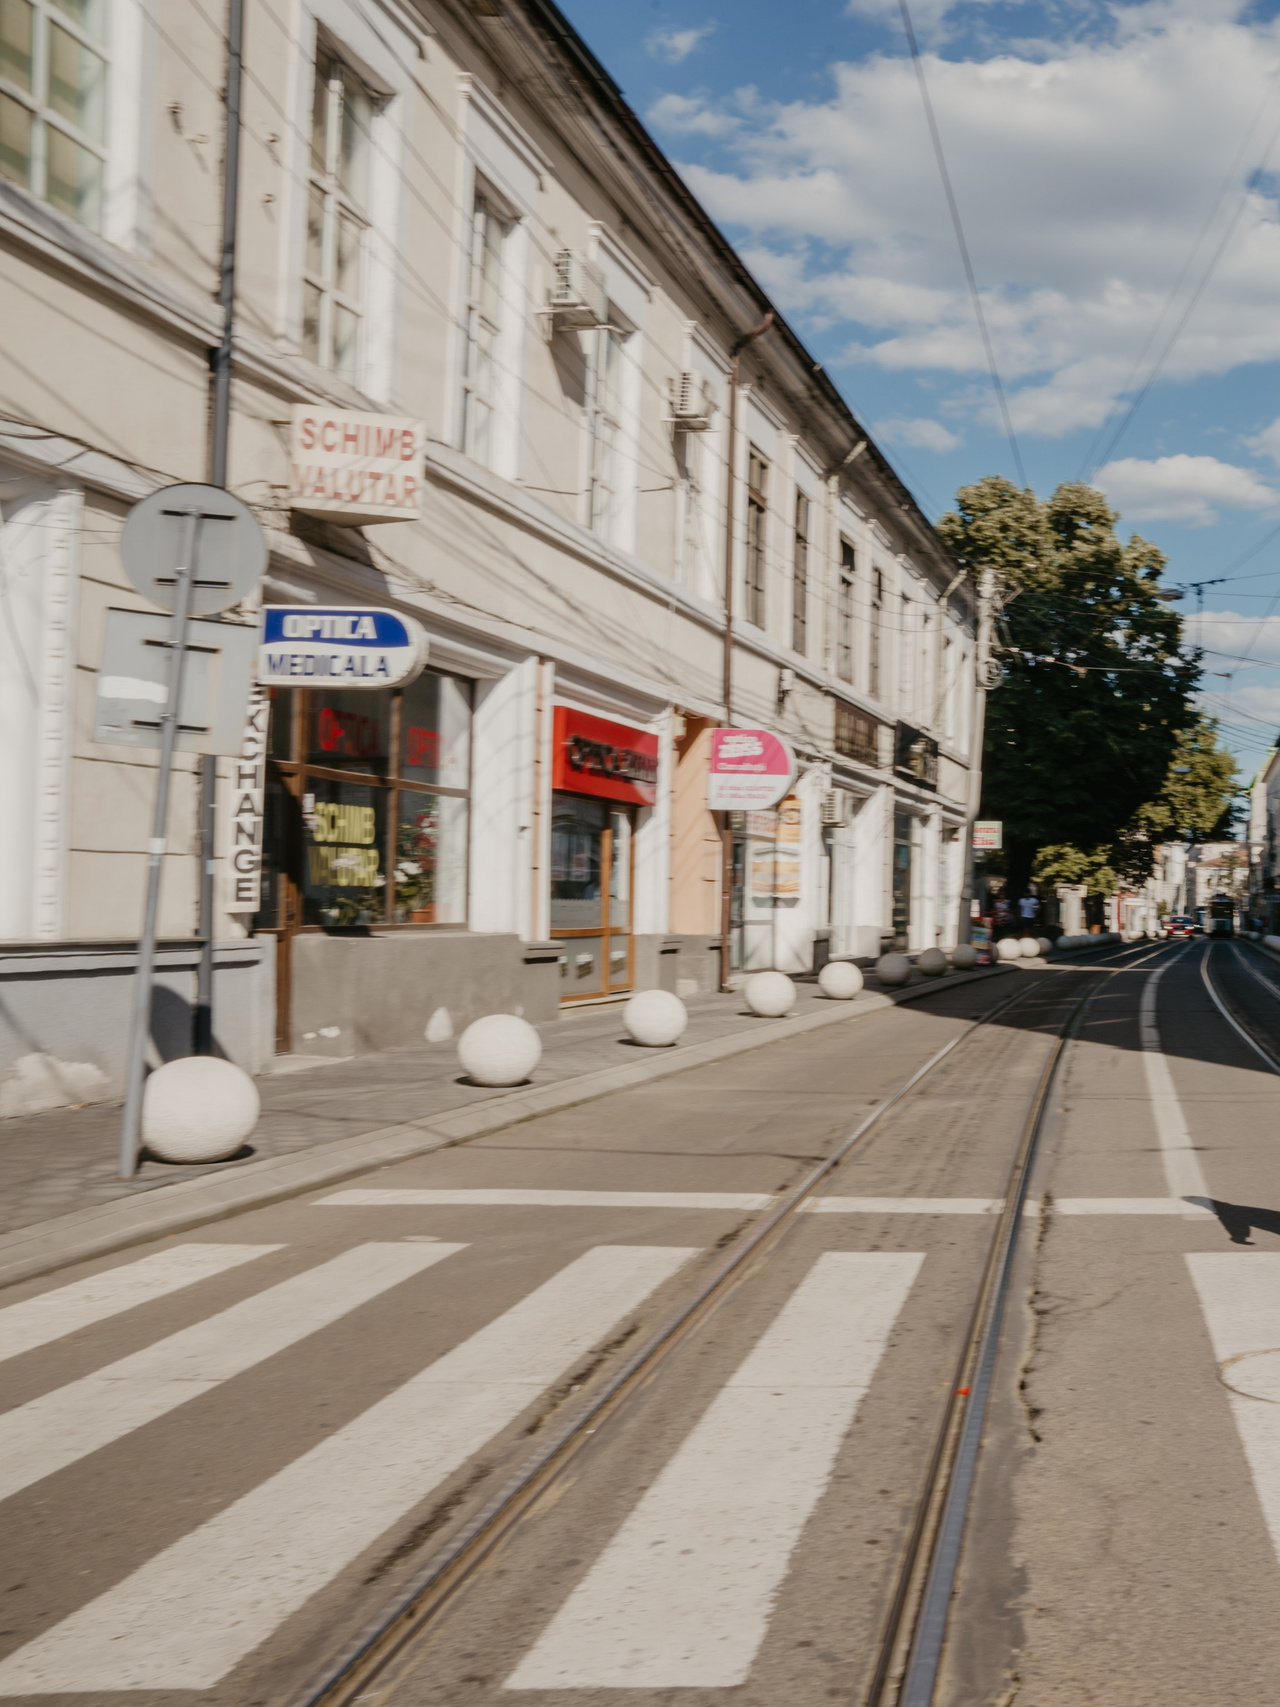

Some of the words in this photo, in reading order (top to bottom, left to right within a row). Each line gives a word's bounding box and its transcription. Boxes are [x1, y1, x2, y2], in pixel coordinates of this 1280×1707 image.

[300, 417, 416, 461] SCHIMB
[291, 463, 419, 508] VALUTAR
[281, 614, 378, 640] OPTICA
[268, 653, 390, 678] MEDICALA
